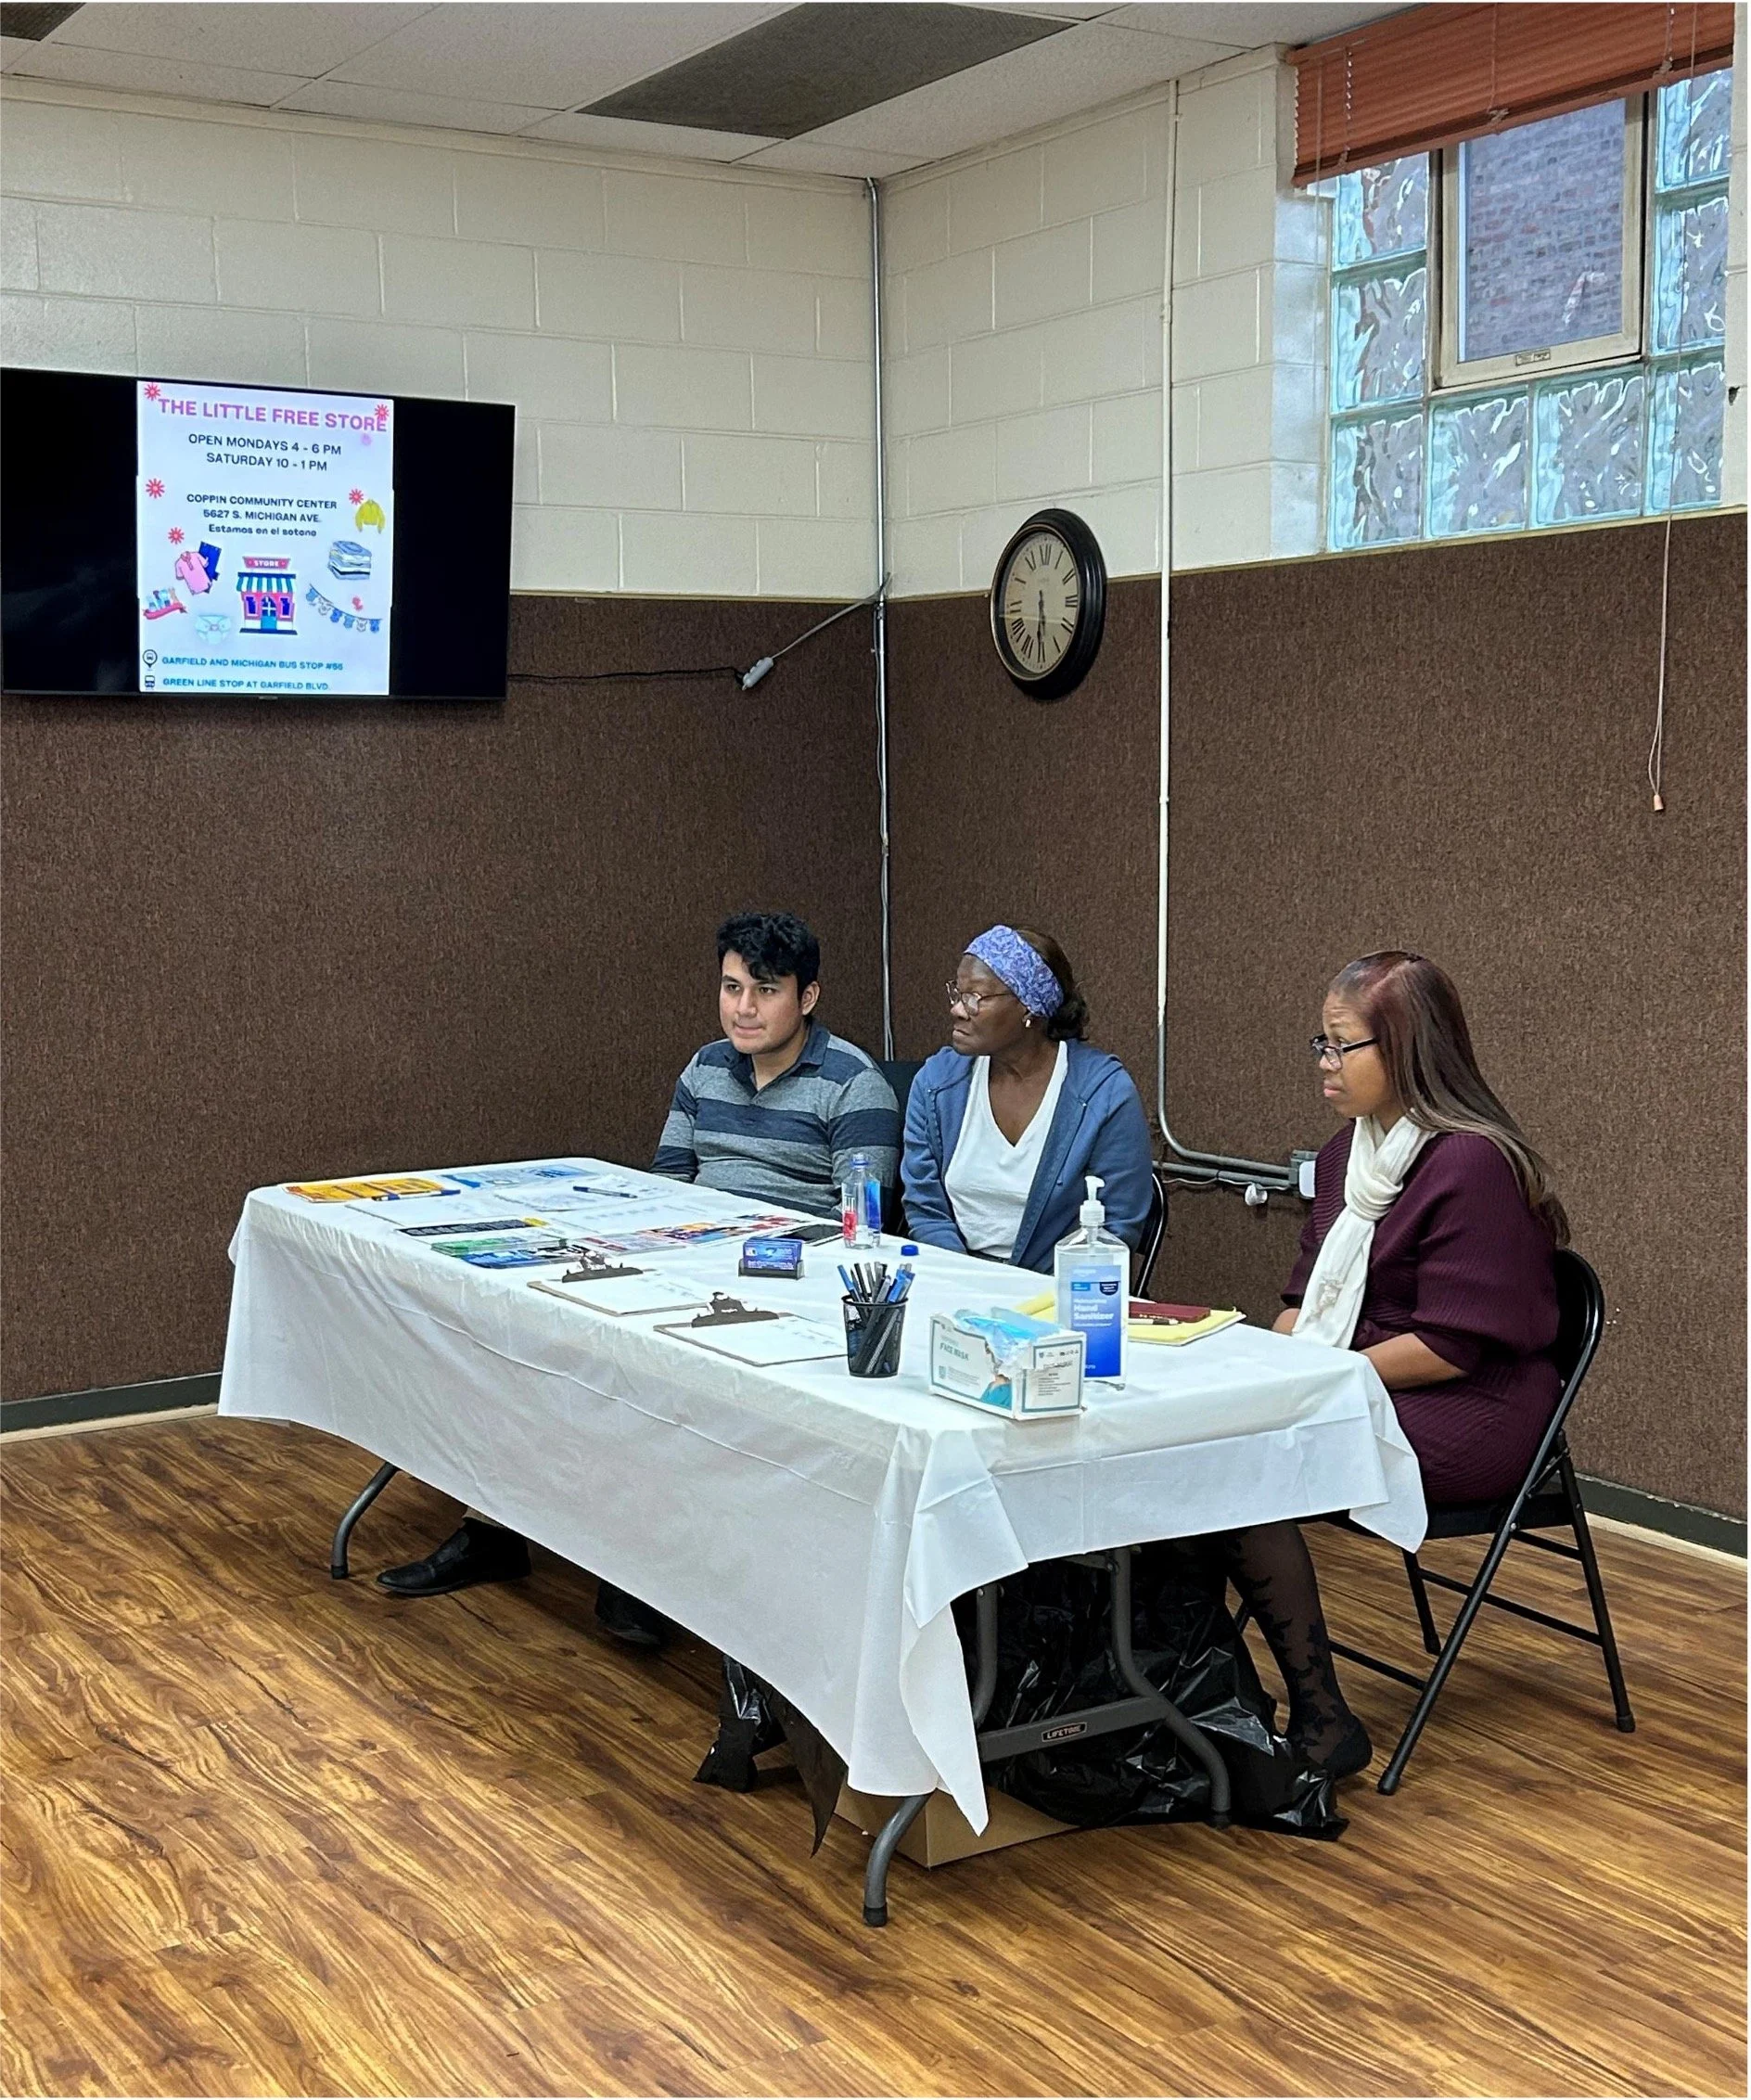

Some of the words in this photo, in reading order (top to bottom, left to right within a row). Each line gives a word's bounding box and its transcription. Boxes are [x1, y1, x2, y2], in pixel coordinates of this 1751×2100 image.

[159, 399, 197, 416] THE
[203, 403, 267, 423] LITTLE
[273, 408, 319, 427] FREE
[325, 413, 387, 432] STORE
[188, 433, 223, 446] OPEN
[226, 436, 288, 451] MONDAYS
[291, 442, 300, 453] 4
[312, 443, 320, 454] 6
[323, 444, 341, 455] PM
[206, 453, 273, 467] SATURDAY
[276, 458, 289, 468] 10
[300, 460, 306, 469] 1
[309, 460, 327, 471] PM
[187, 493, 227, 505] COPPIN
[229, 496, 295, 508] COMMUNITY
[297, 499, 338, 509] CENTER
[203, 509, 230, 519] 5627
[245, 512, 297, 521] MICHIGAN
[209, 523, 254, 534] Estamos
[162, 657, 208, 666] GARFIELD
[232, 659, 276, 668] MICHIGAN
[279, 660, 298, 670] BUS
[163, 678, 195, 686] GREEN
[197, 679, 217, 687] LINE
[220, 679, 244, 688] STOP
[260, 681, 304, 690] GARFIELD
